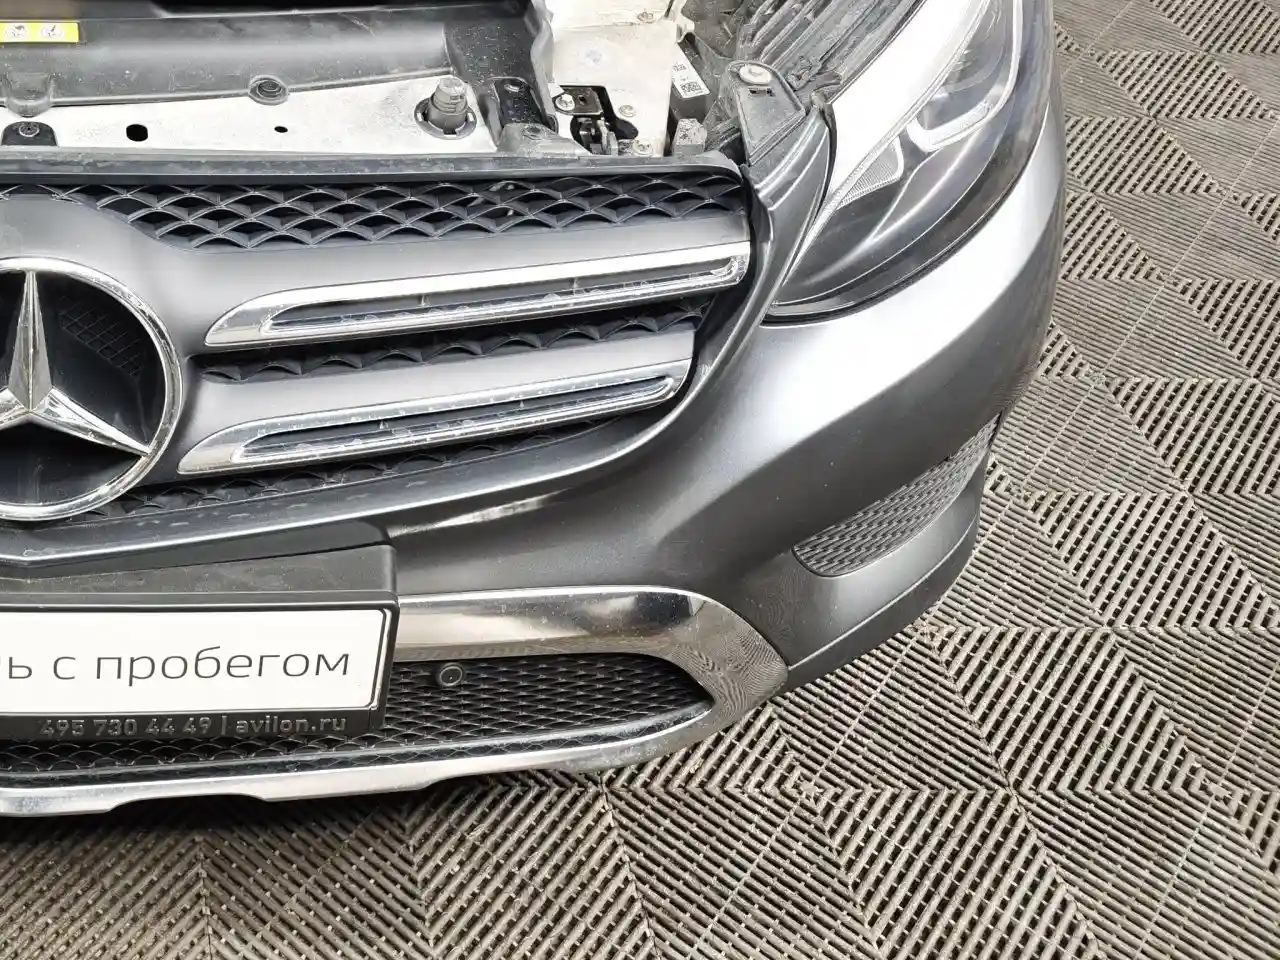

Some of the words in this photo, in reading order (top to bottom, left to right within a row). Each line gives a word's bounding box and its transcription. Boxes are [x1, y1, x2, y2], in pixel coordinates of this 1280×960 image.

[52, 656, 76, 680] с
[96, 645, 350, 687] пробегом
[39, 719, 85, 737] 495
[93, 718, 138, 737] 730
[145, 718, 177, 735] 44
[182, 716, 212, 735] 49
[236, 715, 347, 733] avilon.ru
